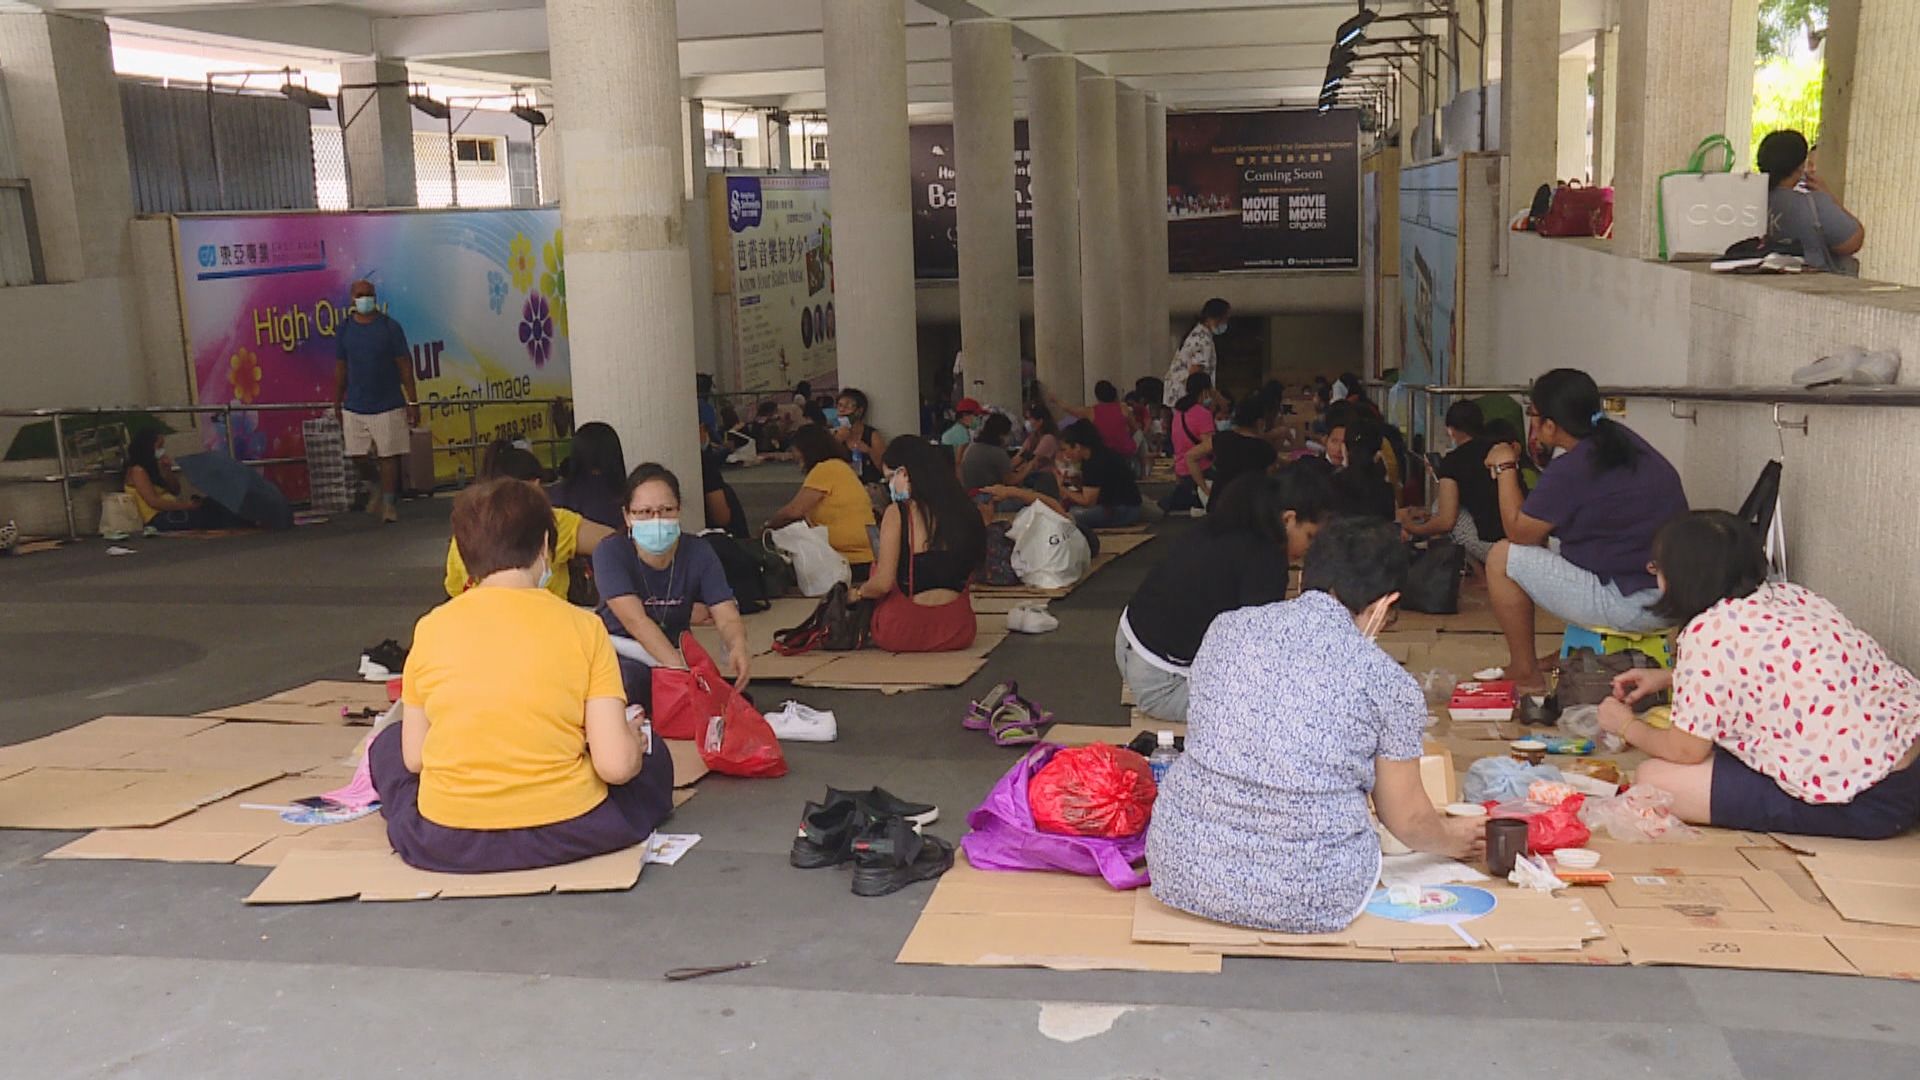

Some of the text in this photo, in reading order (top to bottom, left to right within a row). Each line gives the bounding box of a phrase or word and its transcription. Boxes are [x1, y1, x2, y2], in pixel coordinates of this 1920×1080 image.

[1244, 168, 1323, 183] Coming Soon
[1242, 196, 1280, 210] MOVIE
[1289, 194, 1326, 208] MOVIE
[1242, 209, 1280, 223] MOVIE
[1289, 208, 1326, 221] MOVIE
[1686, 203, 1759, 227] COS
[253, 303, 309, 351] High
[429, 374, 531, 420] Perfect Image
[520, 412, 543, 434] 3168
